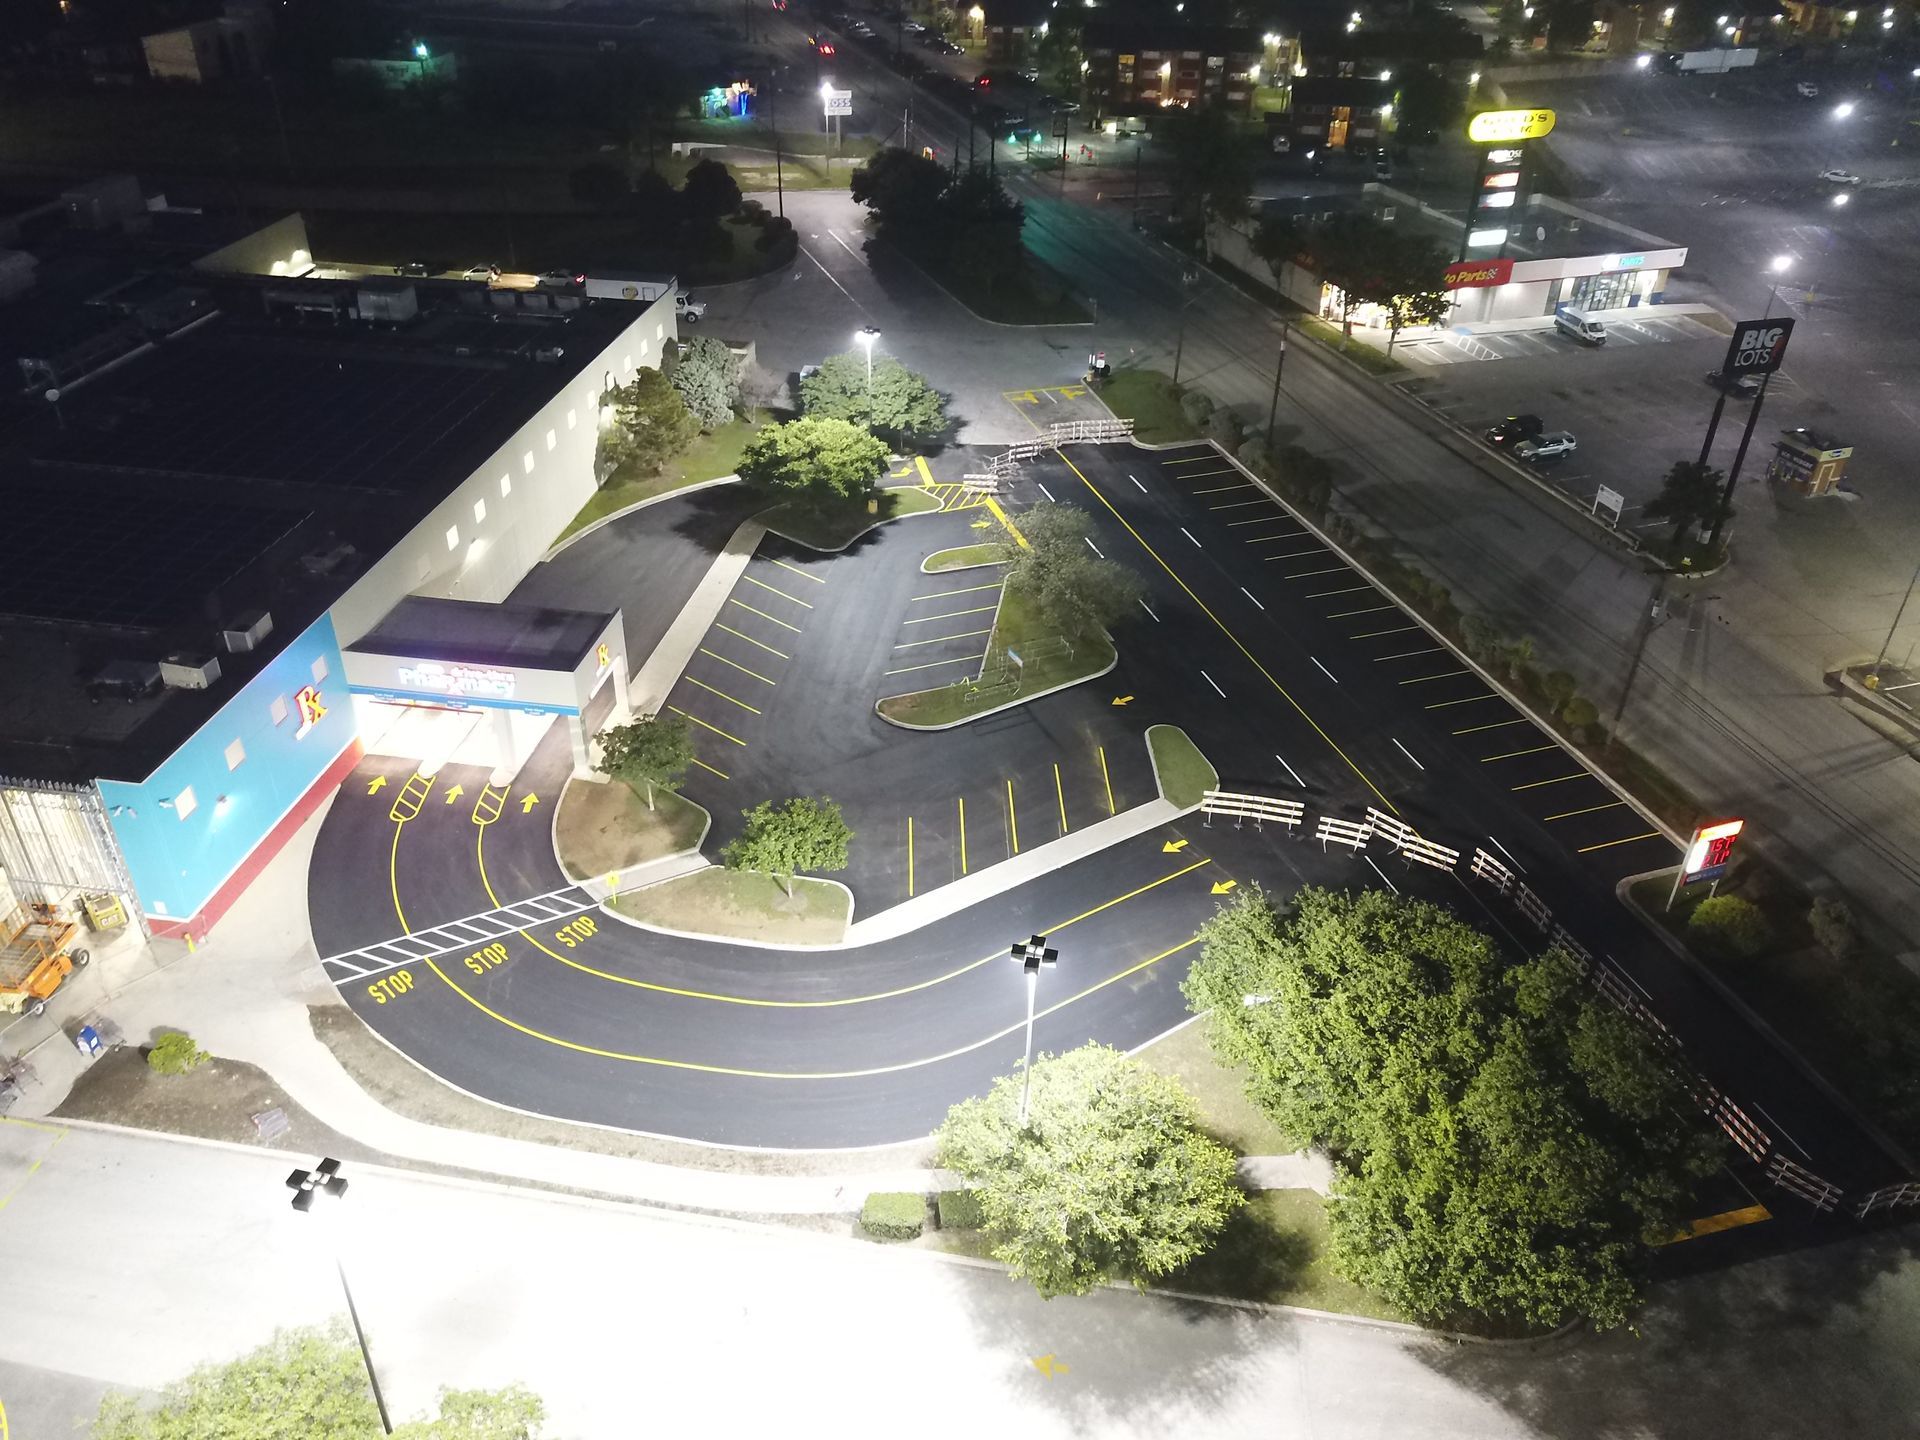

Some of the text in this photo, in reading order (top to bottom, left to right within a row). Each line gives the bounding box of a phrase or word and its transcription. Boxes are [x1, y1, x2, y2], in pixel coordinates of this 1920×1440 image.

[1456, 271, 1487, 282] Parts
[1740, 327, 1784, 350] BIG
[1735, 348, 1771, 367] LOTS
[555, 915, 599, 948] STOP
[464, 942, 509, 975] STOP
[367, 969, 414, 1004] STOP
